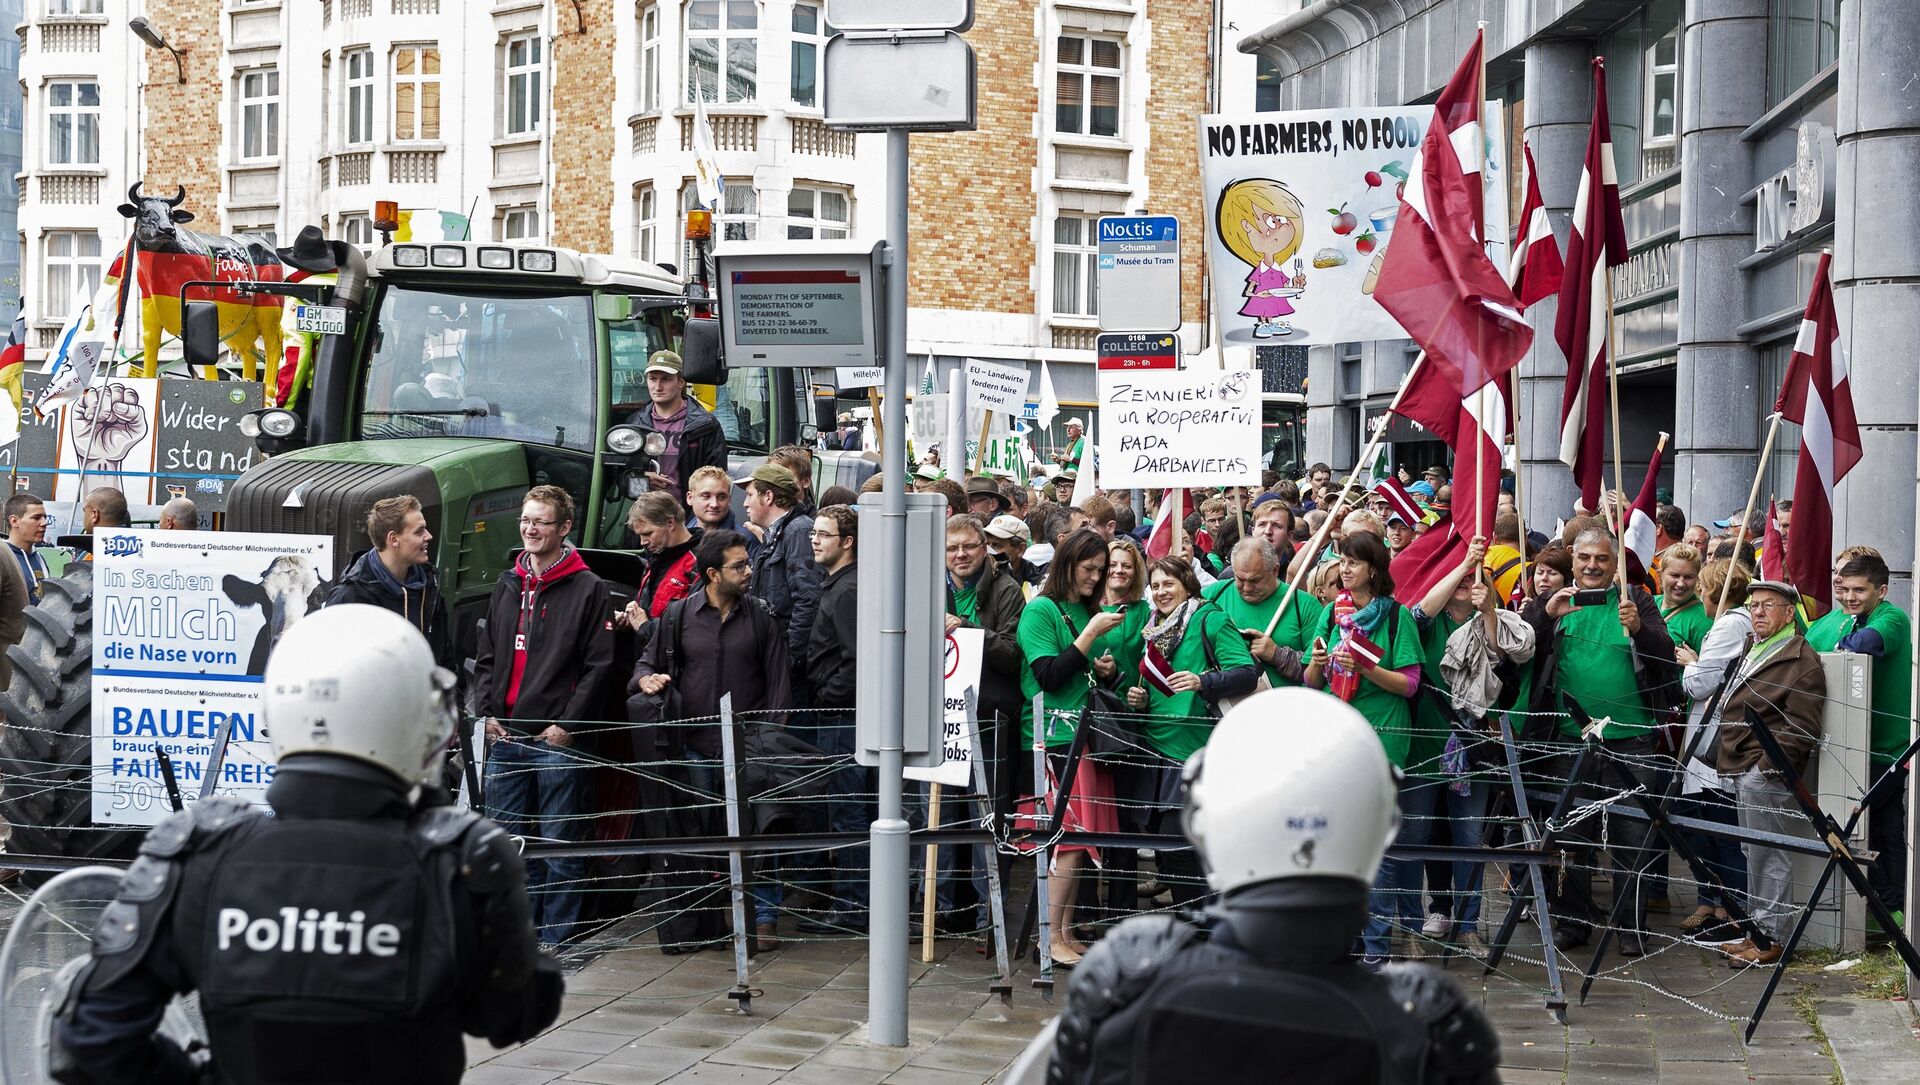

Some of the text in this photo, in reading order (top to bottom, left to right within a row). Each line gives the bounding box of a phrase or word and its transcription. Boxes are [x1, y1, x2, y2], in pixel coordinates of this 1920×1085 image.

[1207, 116, 1421, 157] NO FARMERS, NO FOOD
[1119, 243, 1156, 252] Schuman
[1116, 257, 1141, 265] Musée
[1143, 257, 1153, 265] du
[1154, 257, 1174, 265] Tram
[1612, 243, 1671, 303] CHUMAN
[801, 293, 845, 301] SEPTEMBER,
[306, 308, 322, 320] GM
[315, 320, 343, 333] 1000
[742, 319, 818, 327] BUS 12-21-22-36-60-79
[790, 328, 830, 336] MAELBEEK.
[1102, 341, 1159, 352] COLLECTO
[1123, 359, 1136, 367] 23h
[1141, 359, 1151, 367] 6h
[852, 367, 882, 379] Hilfe(n)!
[970, 365, 980, 375] EU
[987, 369, 1025, 384] Landwirte
[971, 379, 1018, 395] fordern faire
[978, 392, 1005, 405] Preise!
[161, 400, 231, 431] Wider
[1120, 435, 1168, 452] RADA
[164, 440, 253, 473] stand
[1132, 455, 1248, 475] DARBAVIETAS
[198, 481, 223, 494] BDM
[105, 538, 142, 552] BDM
[151, 541, 206, 551] Bundesverband
[207, 543, 243, 552] Deutscher
[245, 544, 299, 554] Milchviehhalter
[104, 567, 214, 592] In Sachen
[103, 595, 236, 642] Milch
[104, 642, 238, 665] die Nase vorn
[113, 686, 164, 696] Bundesverband
[164, 687, 198, 696] Deutscher
[199, 690, 247, 699] Milchviehhalter
[224, 763, 277, 785] REIS
[112, 781, 153, 812] 50
[217, 906, 401, 957] Politie
